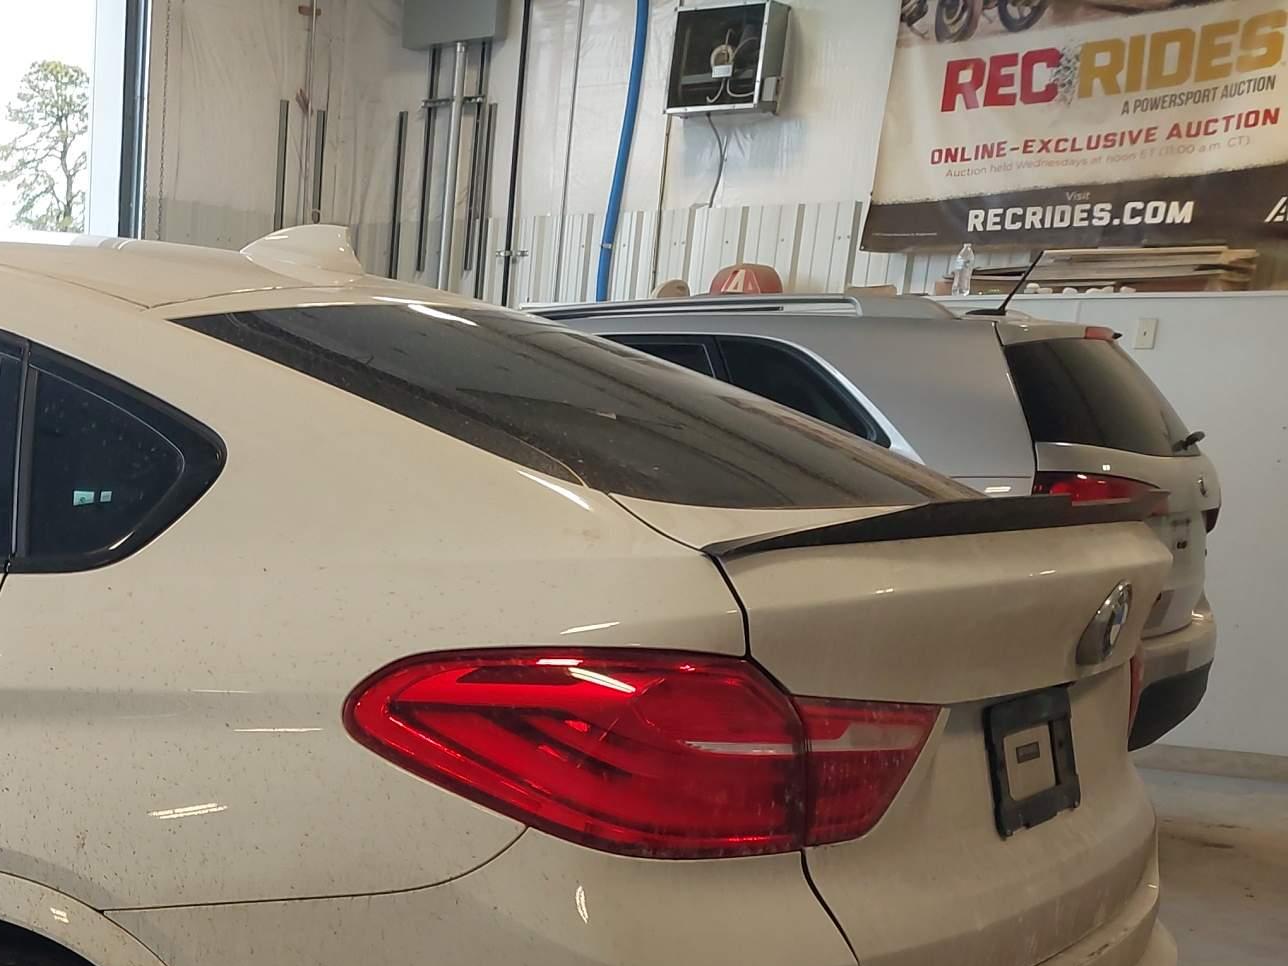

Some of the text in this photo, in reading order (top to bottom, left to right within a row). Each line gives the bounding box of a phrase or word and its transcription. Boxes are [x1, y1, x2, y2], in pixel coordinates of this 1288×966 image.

[941, 9, 1287, 112] REC RIDES
[1121, 75, 1276, 115] A POWERSPORT AUCTION
[931, 107, 1280, 165] ONLINE-EXCLUSIVE AUCTION
[946, 166, 987, 177] Auction
[967, 201, 1194, 232] RECRIDES.COM
